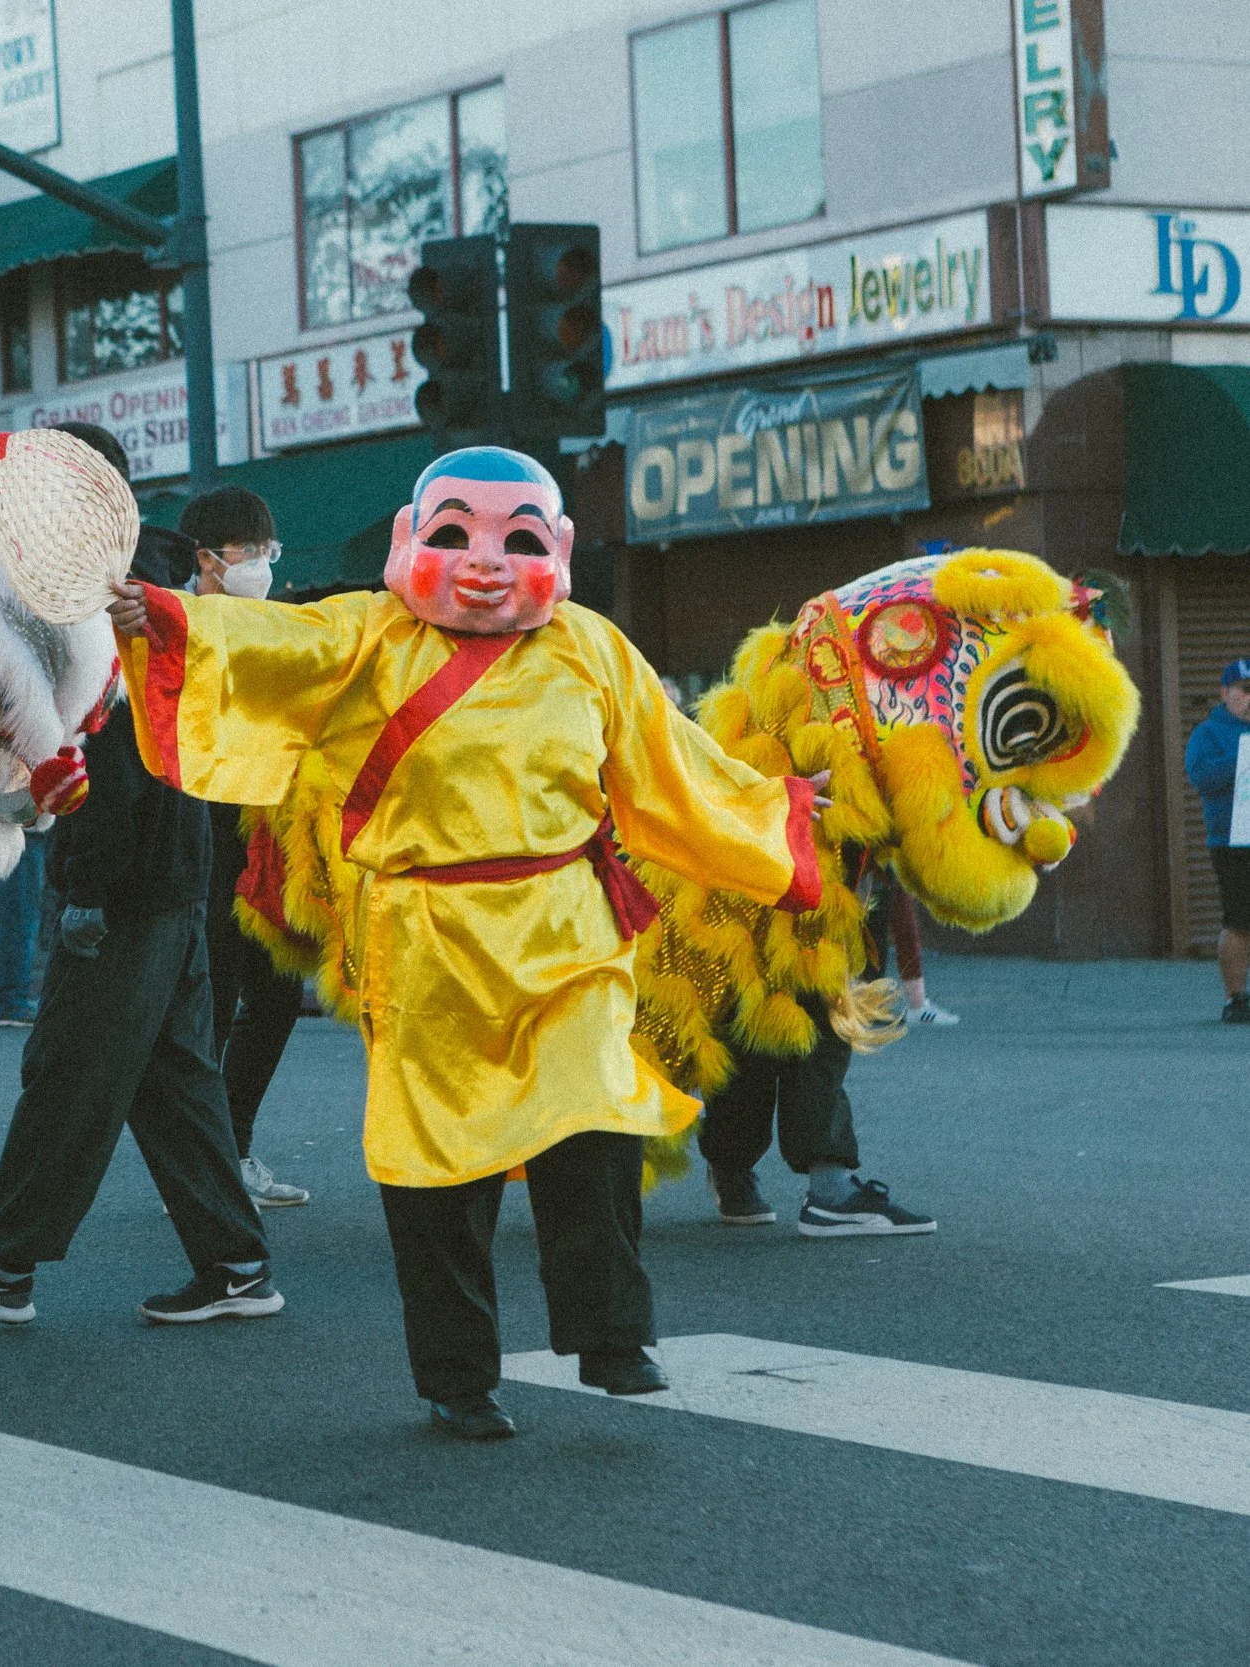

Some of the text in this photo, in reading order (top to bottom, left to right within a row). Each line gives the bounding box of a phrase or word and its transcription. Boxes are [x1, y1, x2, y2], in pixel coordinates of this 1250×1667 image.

[620, 237, 983, 367] Lam's Design Jewelry
[110, 385, 188, 419] OPENIN
[631, 409, 921, 521] OPENING
